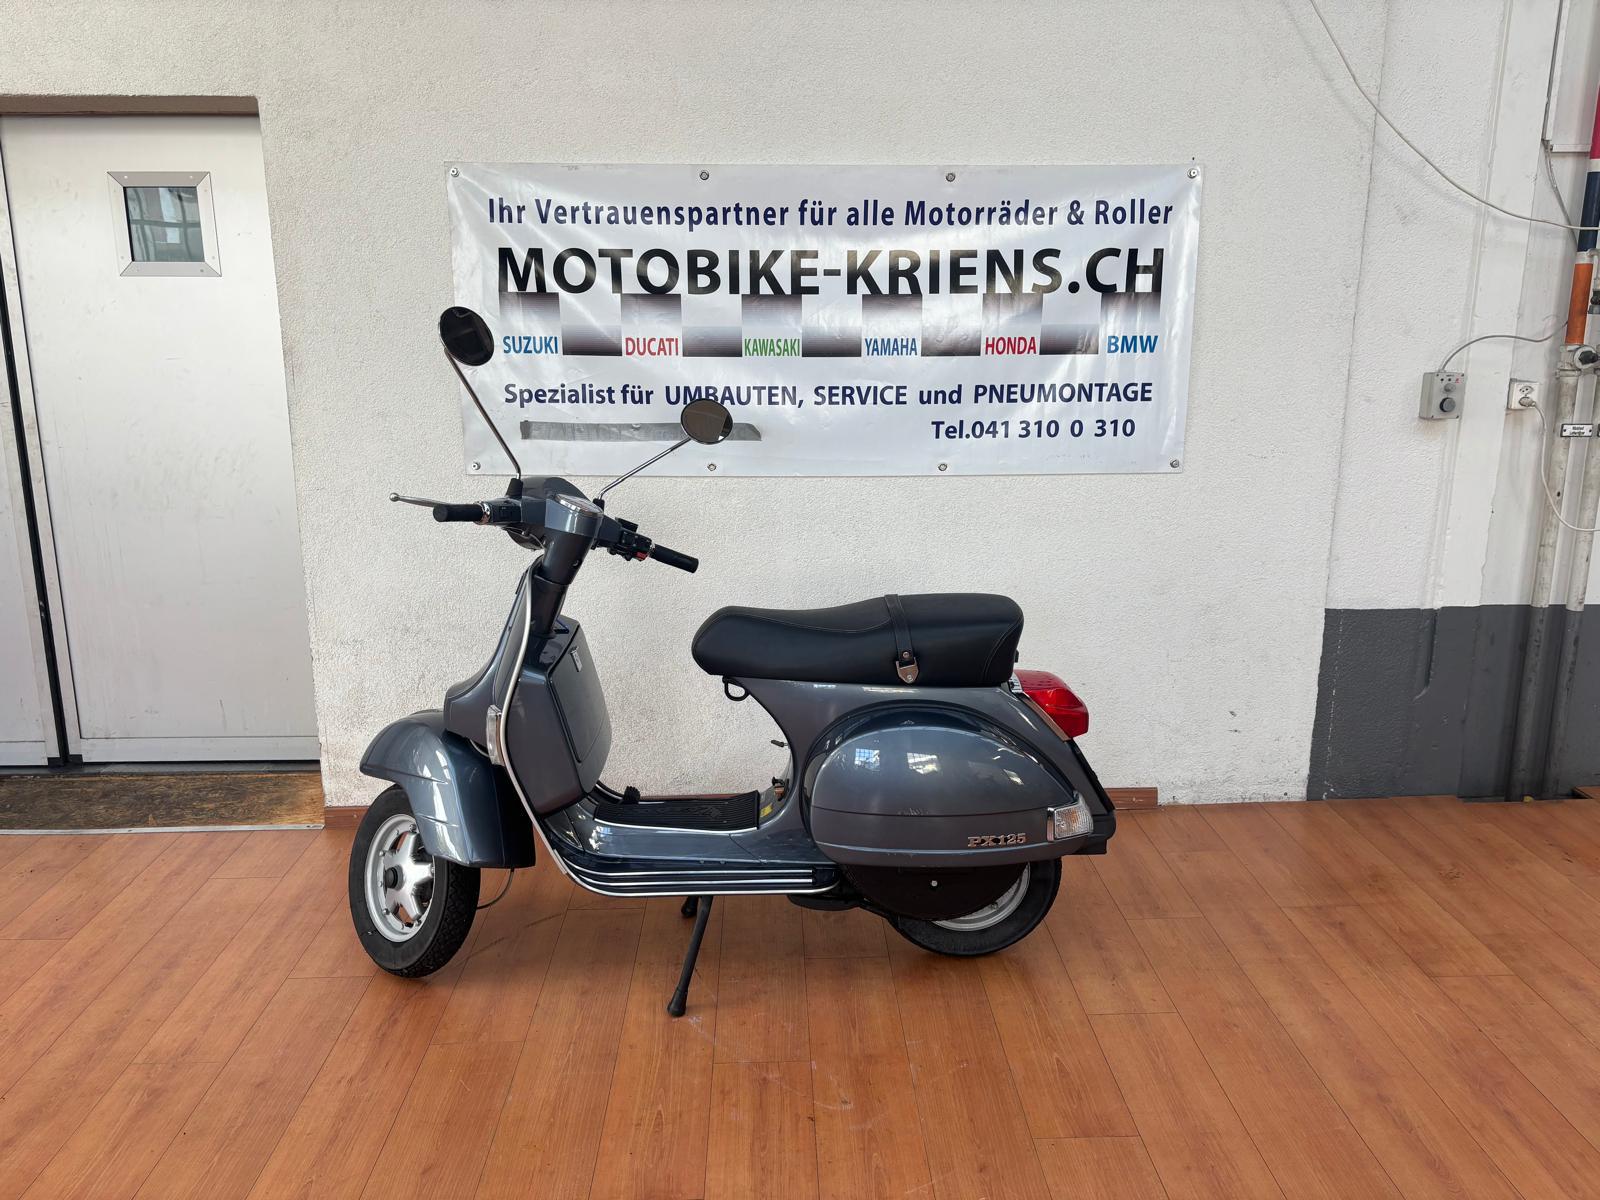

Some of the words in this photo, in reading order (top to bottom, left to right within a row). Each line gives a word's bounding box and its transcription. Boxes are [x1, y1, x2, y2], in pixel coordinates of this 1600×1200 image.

[489, 198, 526, 225] Ihr
[534, 198, 789, 232] Vertrauenspartner
[799, 199, 837, 226] für
[846, 199, 895, 226] alle
[904, 199, 1058, 226] Motorräder
[1066, 200, 1085, 225] &
[1095, 198, 1173, 225] Roller
[498, 247, 1165, 295] MOTOBIKE-KRIENS.CH
[502, 336, 559, 355] SUZUKI
[625, 337, 679, 356] DUCATI
[744, 337, 801, 357] KAWASAKI
[864, 337, 918, 357] YAMAHA
[984, 336, 1037, 355] HONDA
[1107, 335, 1159, 354] BMW
[504, 383, 615, 408] Spezialist
[621, 384, 654, 405] für
[665, 385, 804, 409] UMBAUTEN,
[814, 385, 908, 406] SERVICE
[919, 384, 963, 405] und
[973, 382, 1153, 404] PNEUMONTAGE
[1018, 419, 1060, 439] 310
[1069, 419, 1084, 438] 0
[1094, 418, 1136, 438] 310
[967, 832, 1026, 847] PX125
